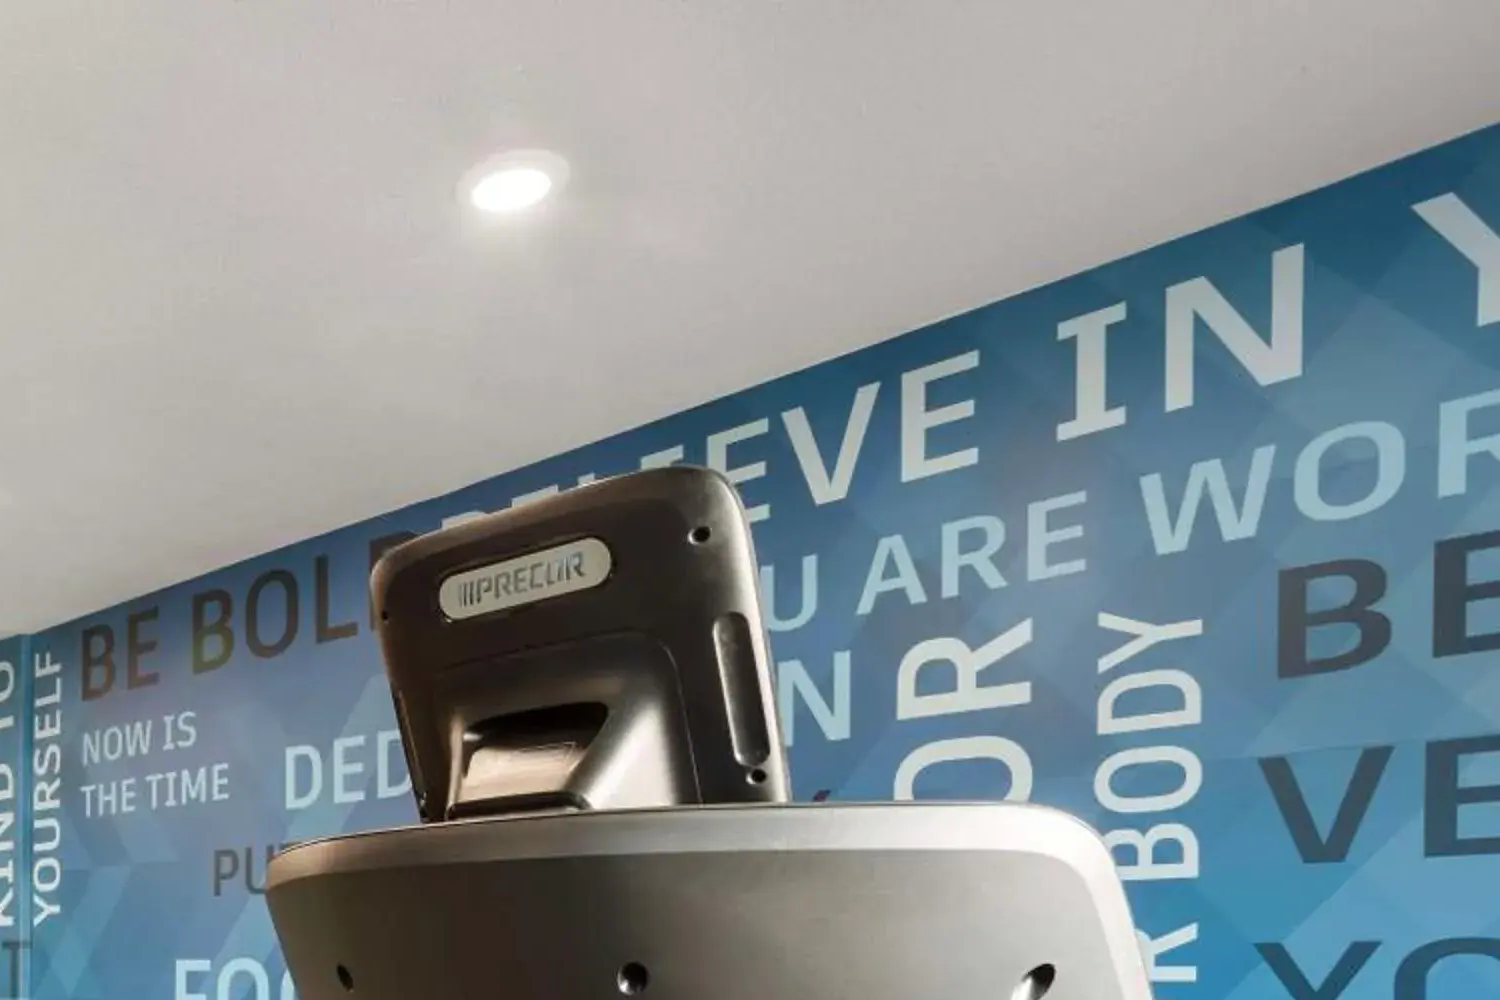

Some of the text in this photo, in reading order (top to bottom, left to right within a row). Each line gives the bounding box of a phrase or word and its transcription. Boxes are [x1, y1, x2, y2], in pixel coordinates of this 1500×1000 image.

[1056, 243, 1305, 442] IN
[81, 531, 422, 701] BE BOL
[462, 551, 587, 607] PRECOR
[856, 490, 1088, 616] ARE
[32, 651, 63, 925] YOURSELF
[80, 763, 230, 818] THE TIME
[82, 711, 197, 767] NOW IS
[1094, 611, 1204, 881] BODY
